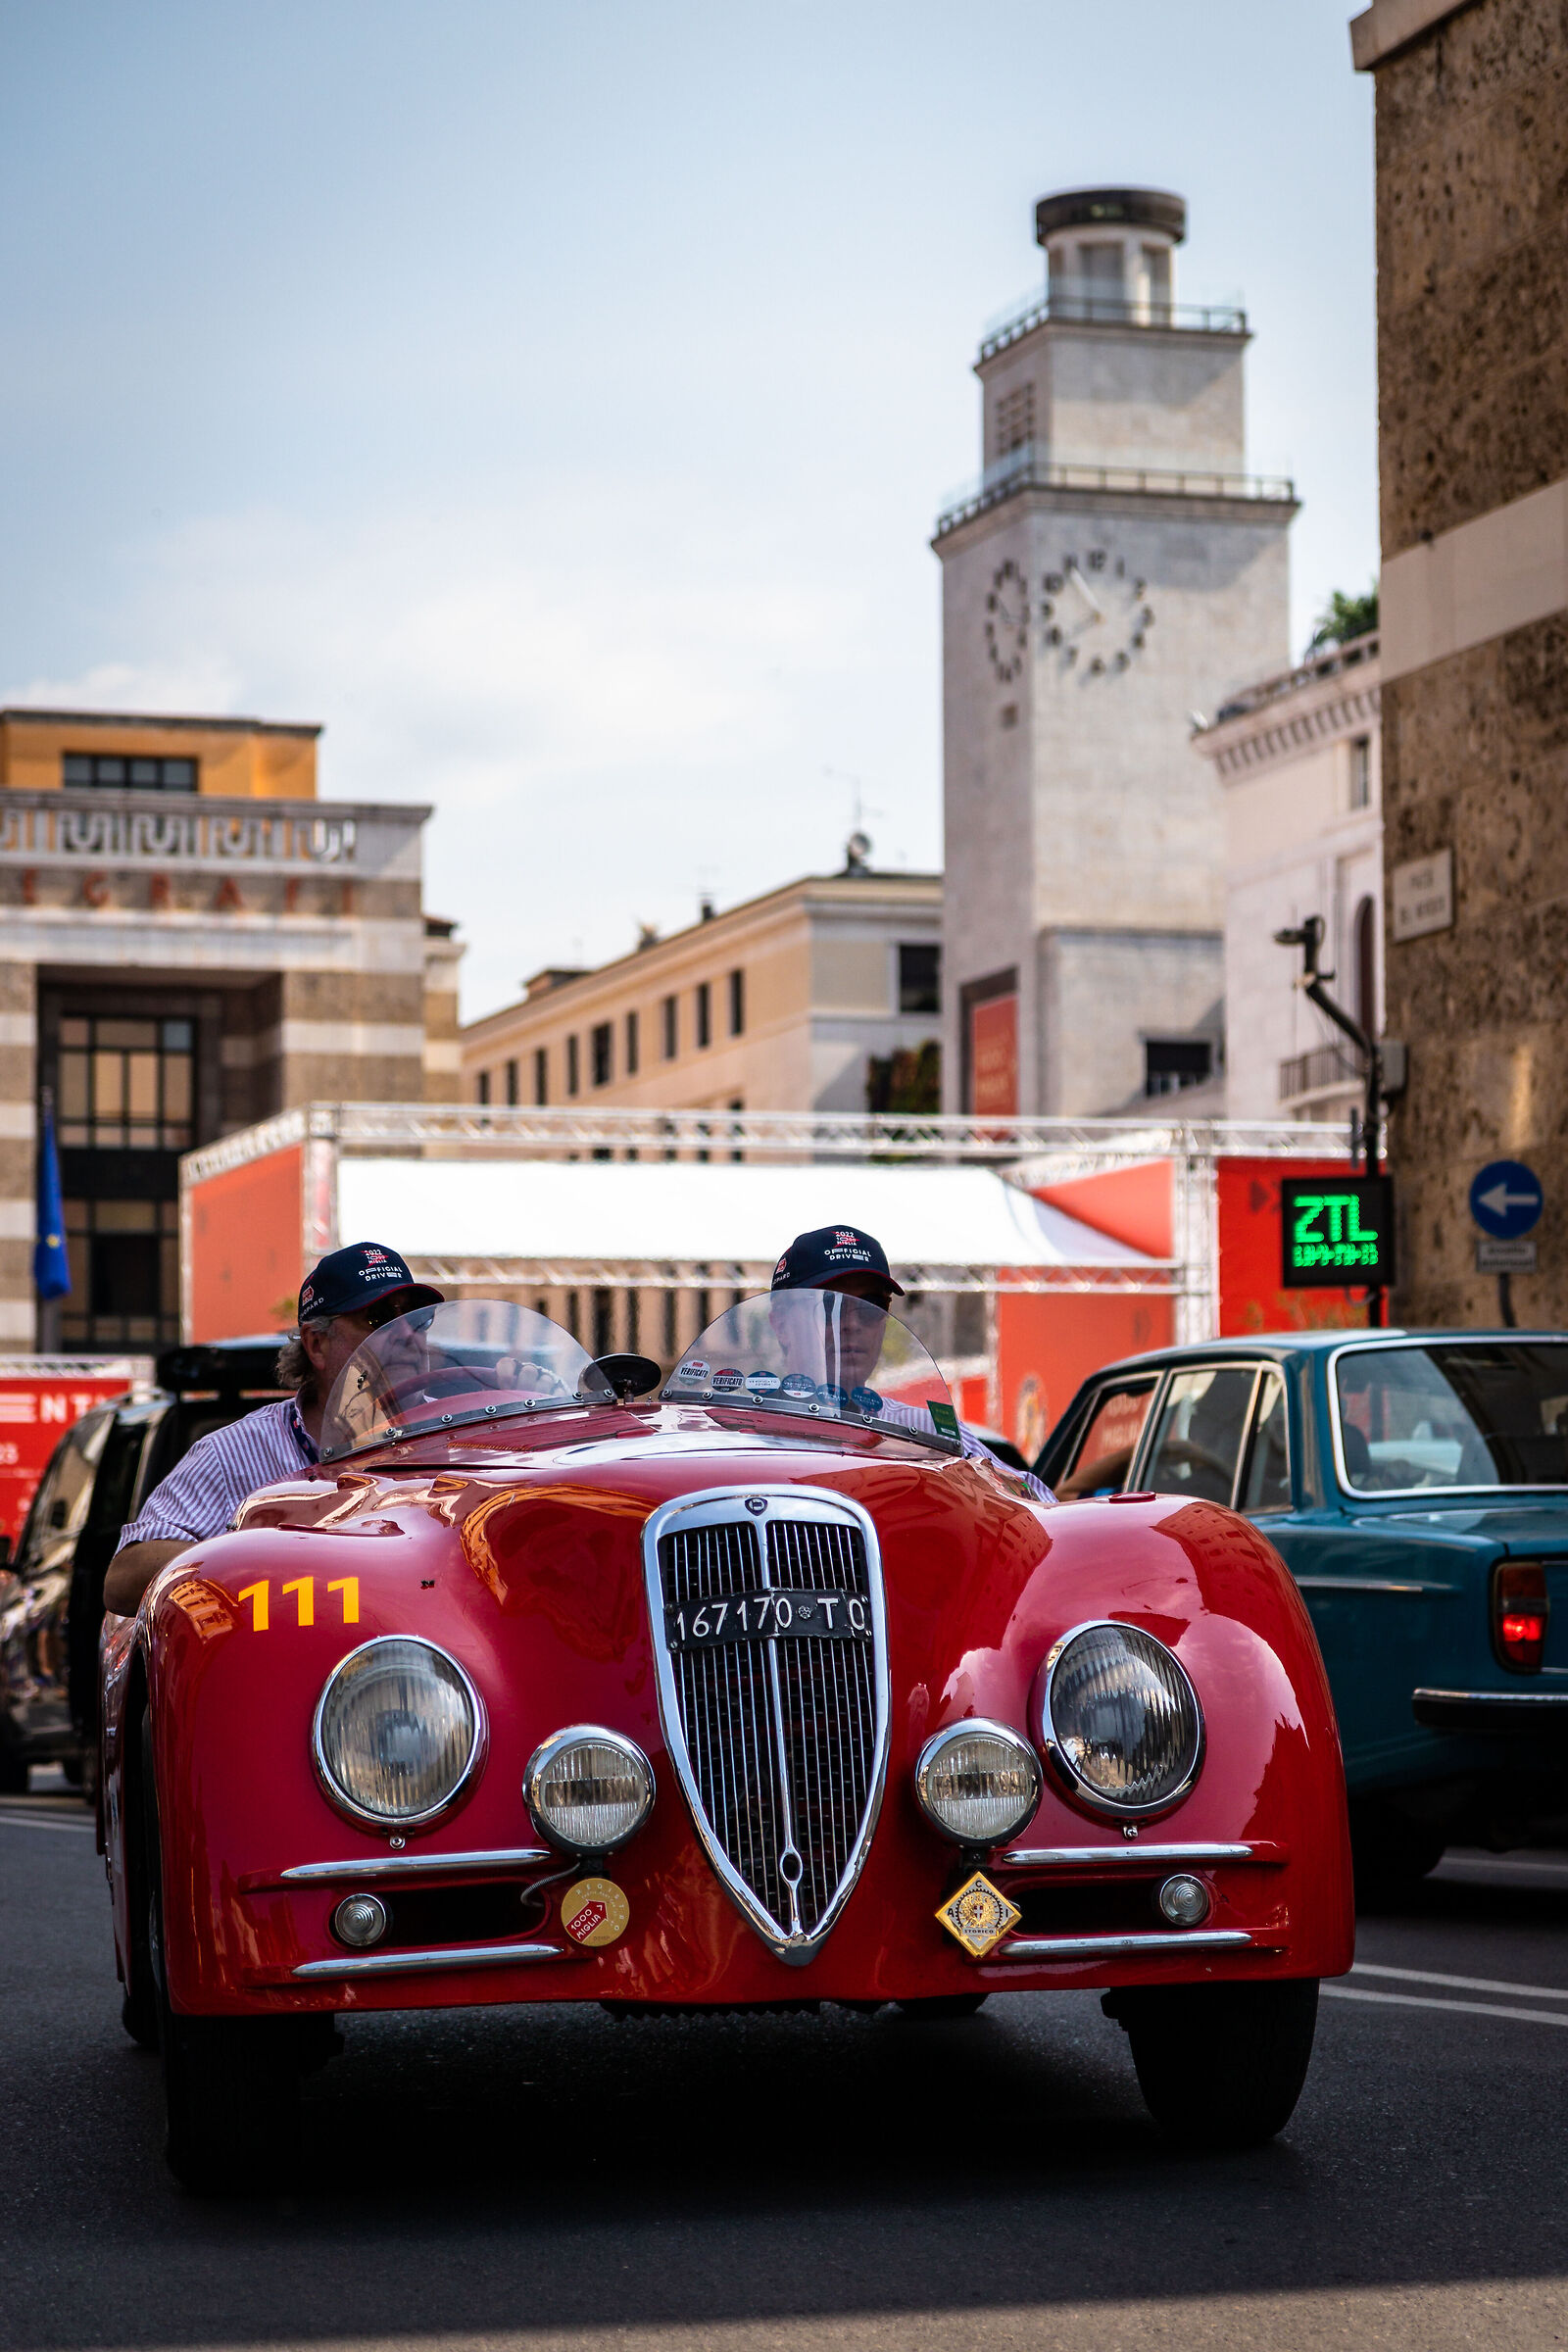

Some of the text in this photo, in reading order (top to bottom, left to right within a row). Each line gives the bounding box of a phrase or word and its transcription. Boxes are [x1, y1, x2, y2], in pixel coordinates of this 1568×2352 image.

[1293, 1194, 1379, 1243] ZTL
[680, 1367, 709, 1378] VERIFICATO
[712, 1377, 743, 1386] VERIFICATO
[238, 1576, 359, 1632] 111
[676, 1597, 865, 1642] 167170 TO
[570, 1908, 593, 1931] 1000
[576, 1914, 601, 1939] MIGLIA
